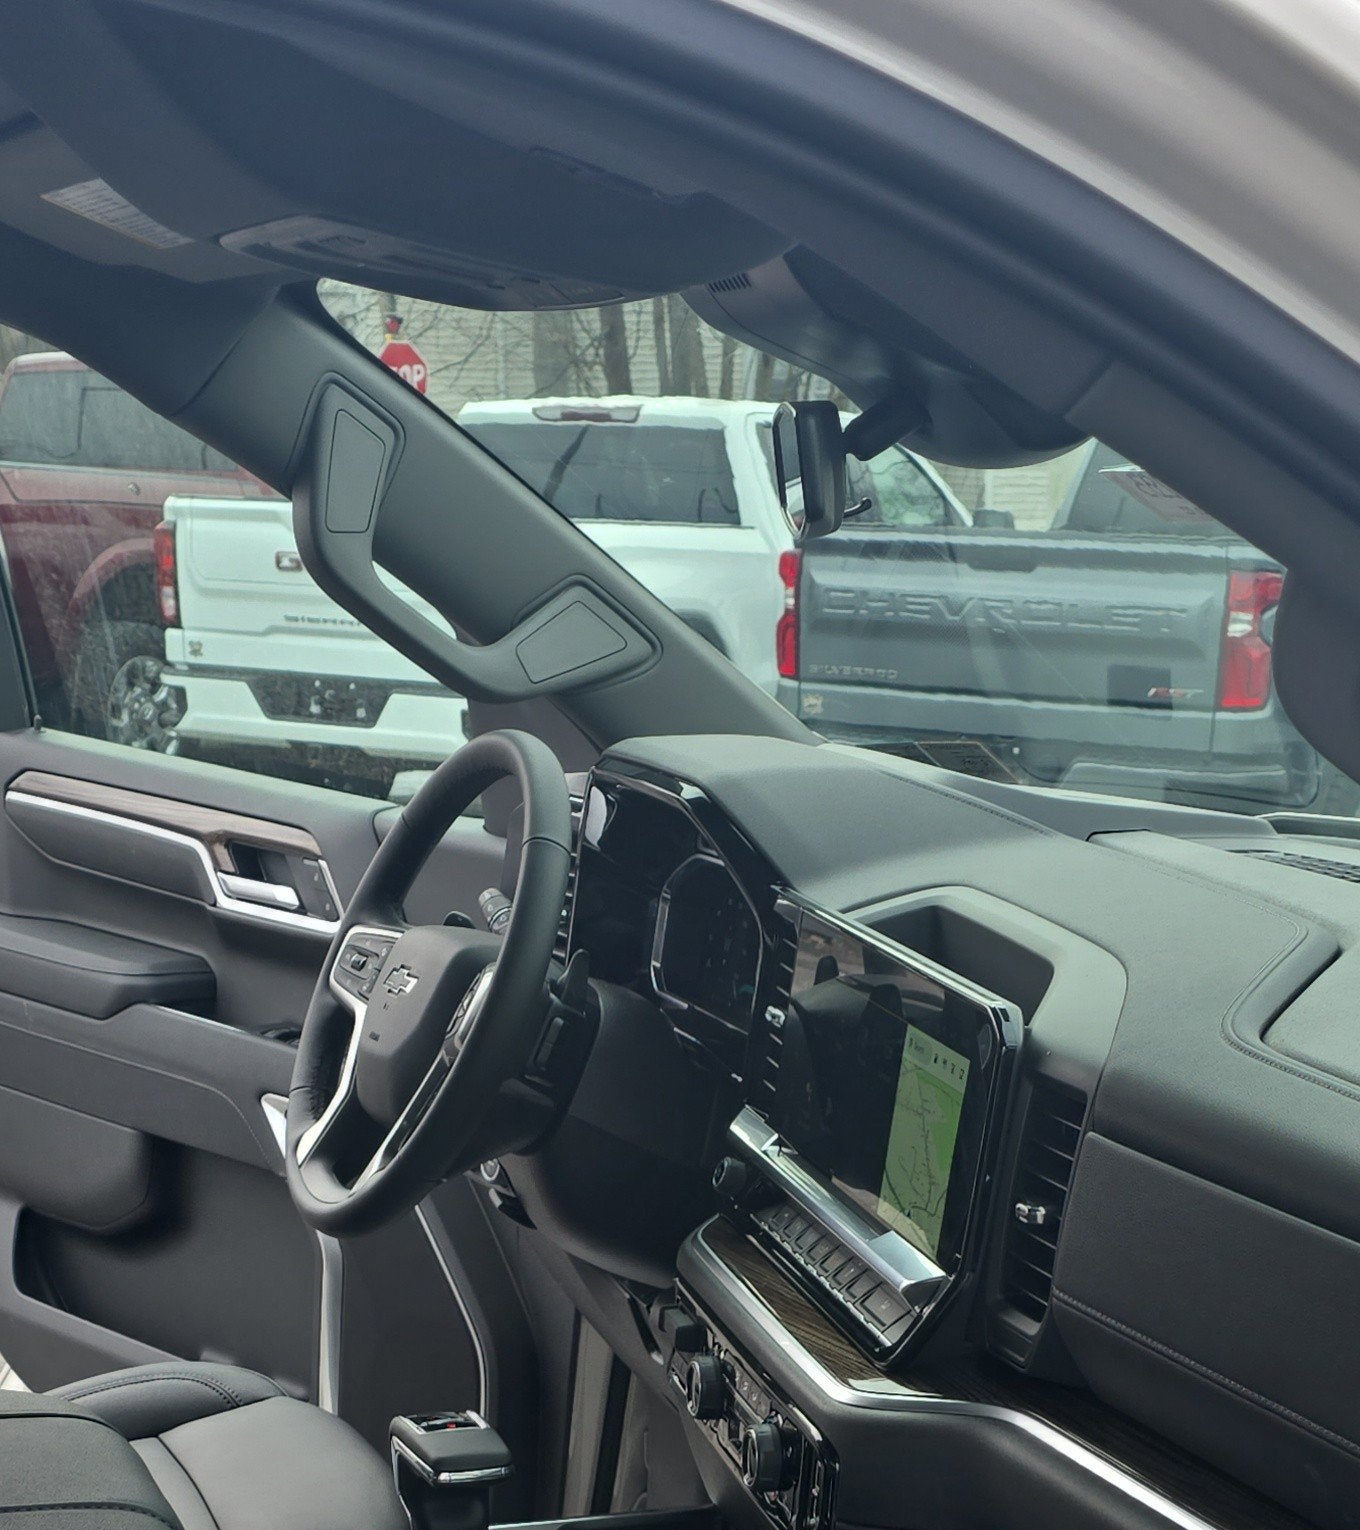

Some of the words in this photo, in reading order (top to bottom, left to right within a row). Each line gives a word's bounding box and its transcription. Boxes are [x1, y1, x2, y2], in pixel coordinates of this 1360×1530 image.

[389, 364, 425, 391] OP
[822, 587, 1189, 634] CHEVROLET
[806, 662, 899, 680] SILVERADO
